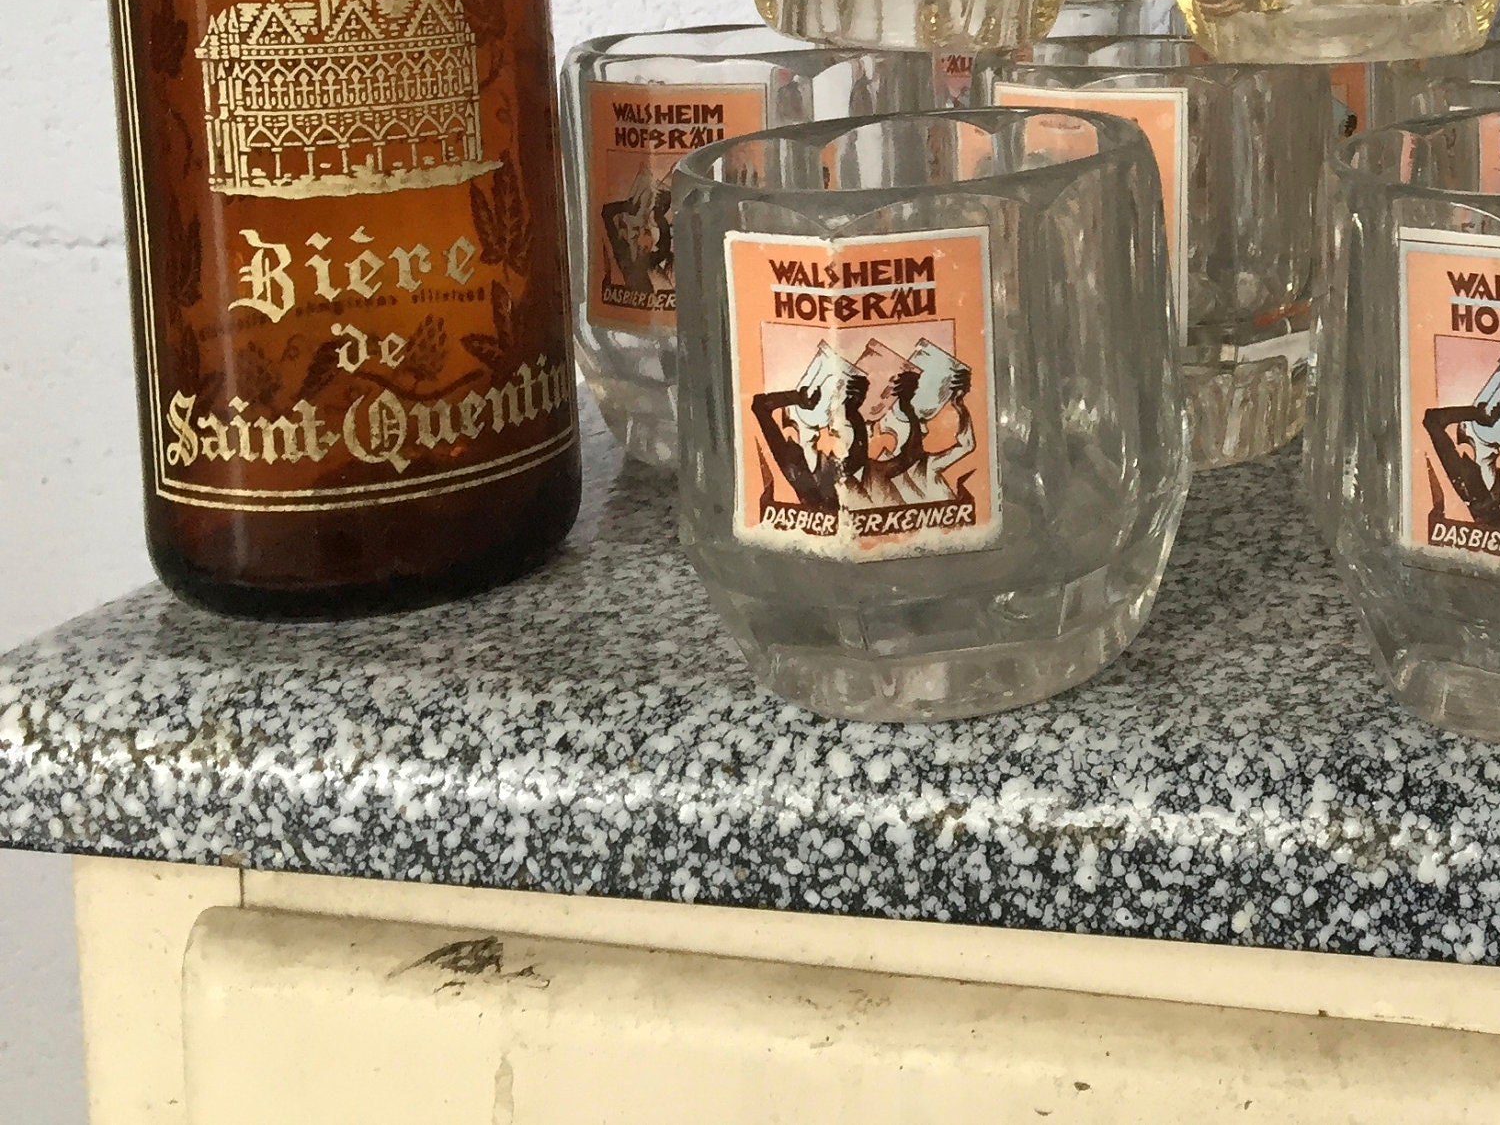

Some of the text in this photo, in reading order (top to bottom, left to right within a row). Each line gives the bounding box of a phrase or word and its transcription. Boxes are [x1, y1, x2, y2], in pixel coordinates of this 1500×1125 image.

[613, 102, 723, 124] WALSHEIM
[615, 127, 723, 149] HOFBRÄU
[228, 225, 477, 323] Bière
[769, 256, 936, 288] WALSHEIM
[774, 287, 937, 322] HOFBRÄU
[331, 322, 407, 374] de
[166, 353, 569, 472] Saint-Quentin
[882, 503, 973, 533] KENNER
